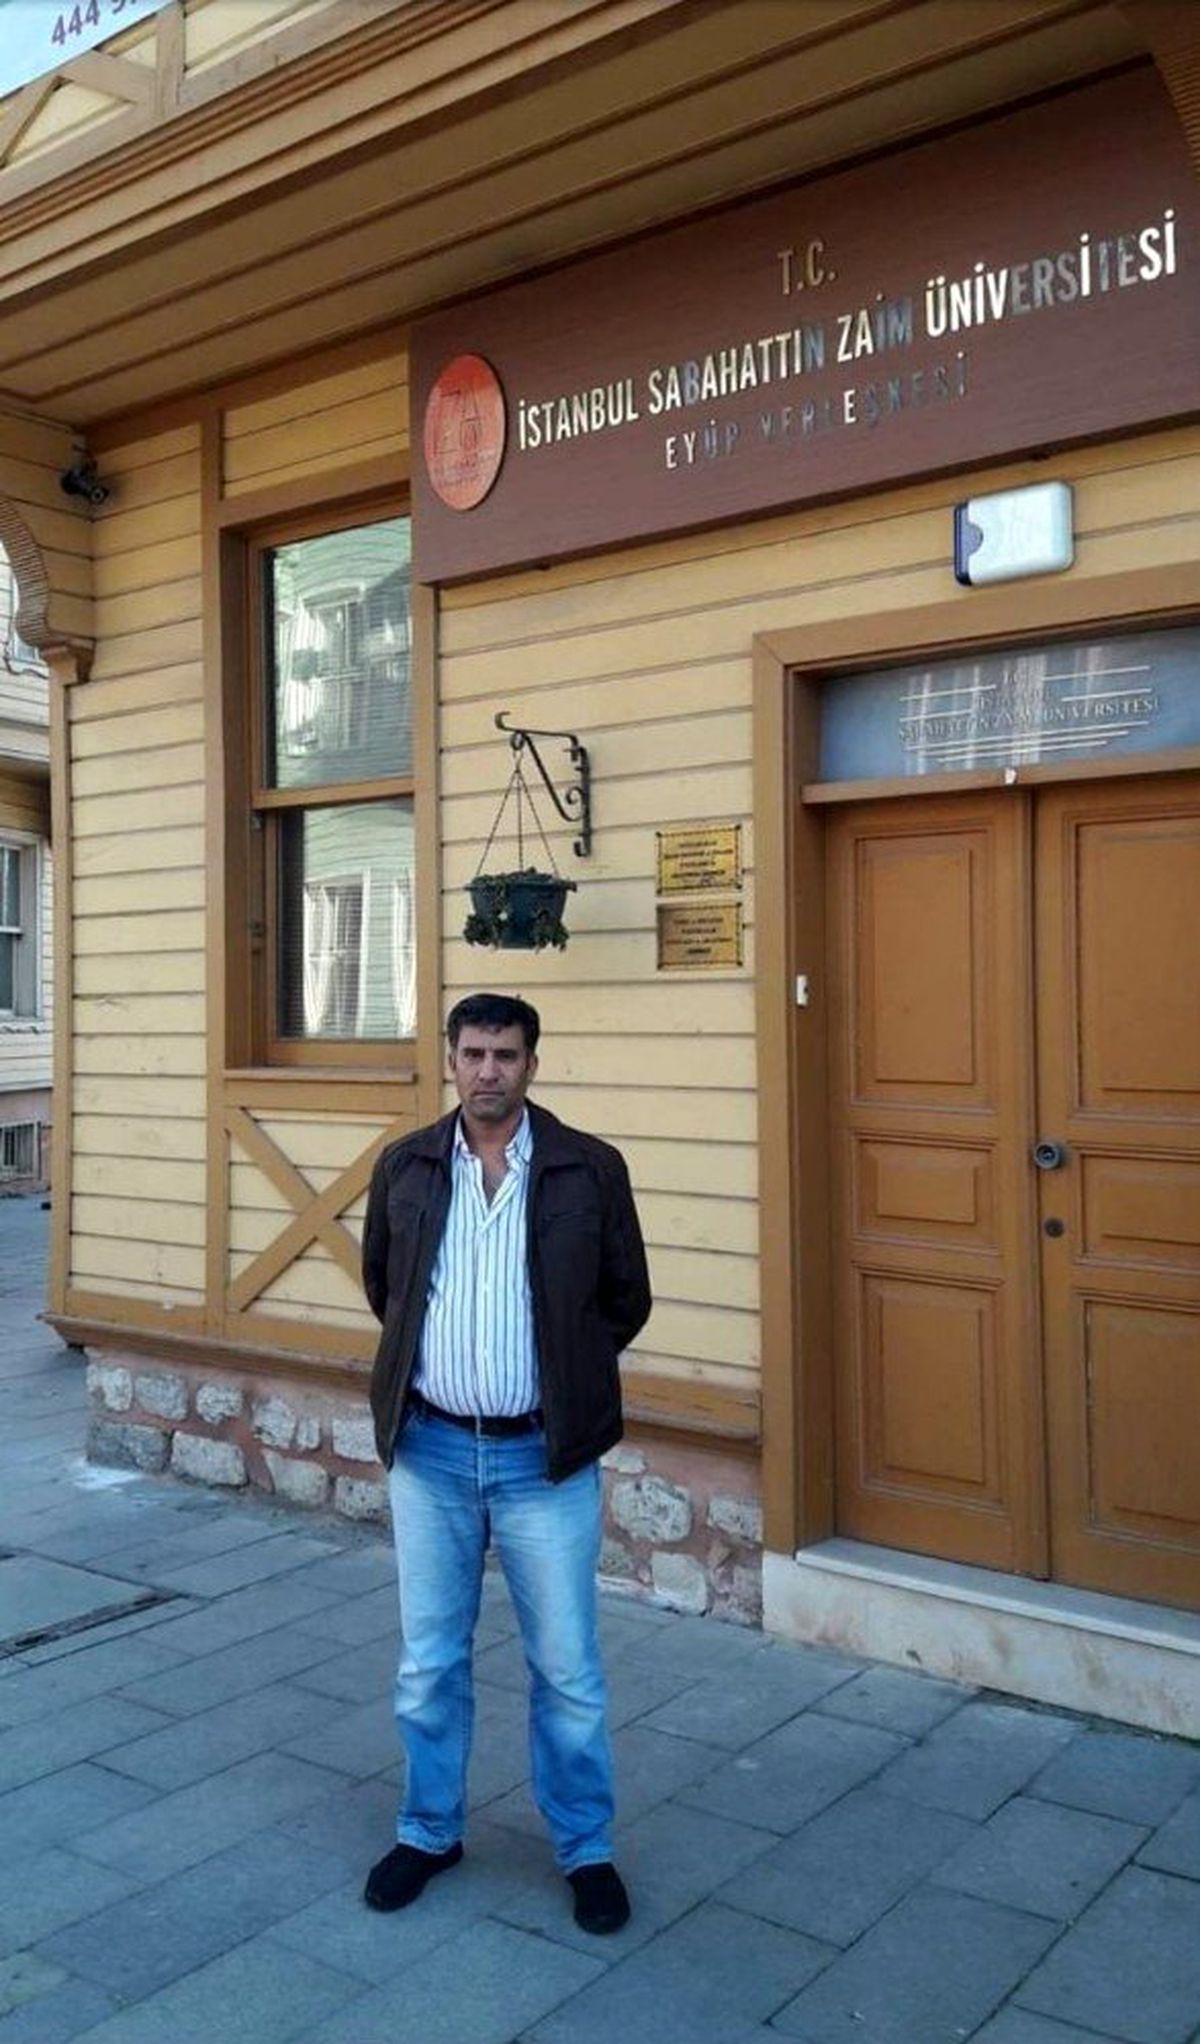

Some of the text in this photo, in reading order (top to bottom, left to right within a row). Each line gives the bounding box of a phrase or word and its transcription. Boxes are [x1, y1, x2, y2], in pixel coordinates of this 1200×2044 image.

[51, 0, 100, 45] 444
[777, 240, 837, 295] T.C.
[518, 379, 639, 450] İSTANBUL
[836, 293, 913, 362] ZAİM
[925, 208, 1177, 338] ÜNİVERSİTESİ
[665, 419, 738, 469] EYÜP
